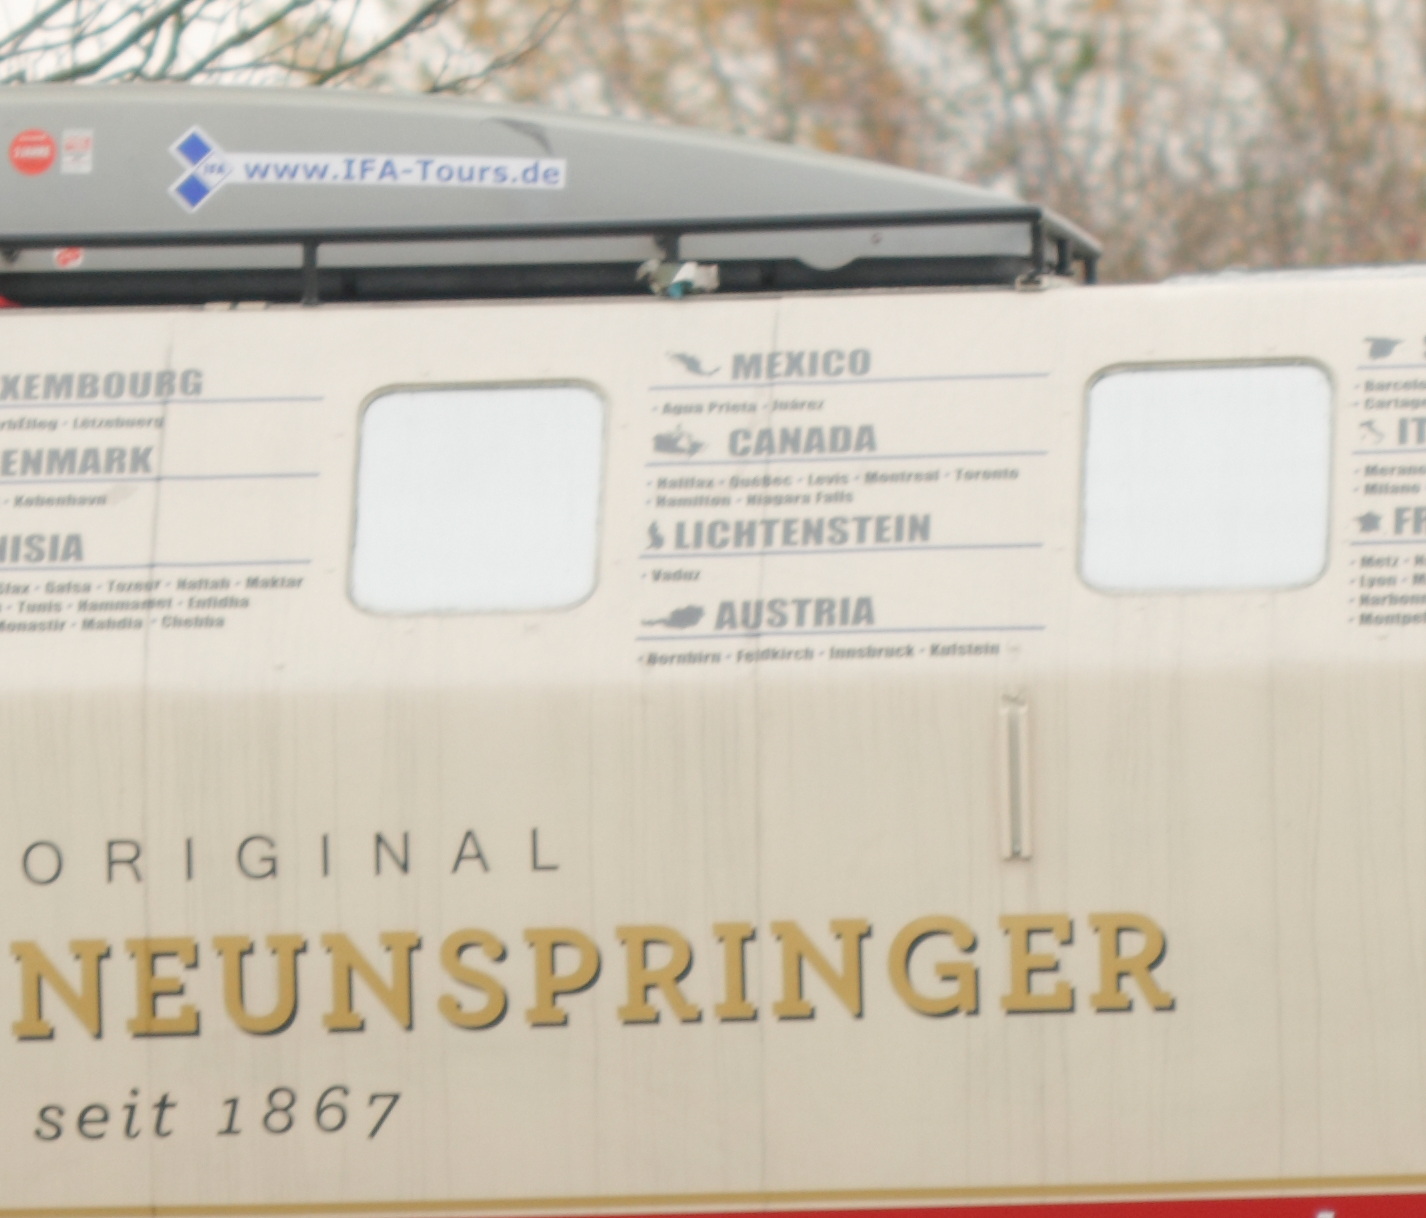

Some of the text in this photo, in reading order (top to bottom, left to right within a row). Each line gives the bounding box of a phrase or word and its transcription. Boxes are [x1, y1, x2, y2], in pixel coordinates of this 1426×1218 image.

[244, 158, 561, 185] www.IFA-Tours.de
[731, 348, 870, 380] MEXICO
[728, 424, 876, 457] CANADA
[674, 514, 930, 549] LICHTENSTEIN
[714, 597, 874, 631] AUSTRIA
[21, 826, 560, 886] ORIGINAL
[11, 912, 1176, 1041] NEUNSPRINGER
[33, 1084, 403, 1142] seit 1867
